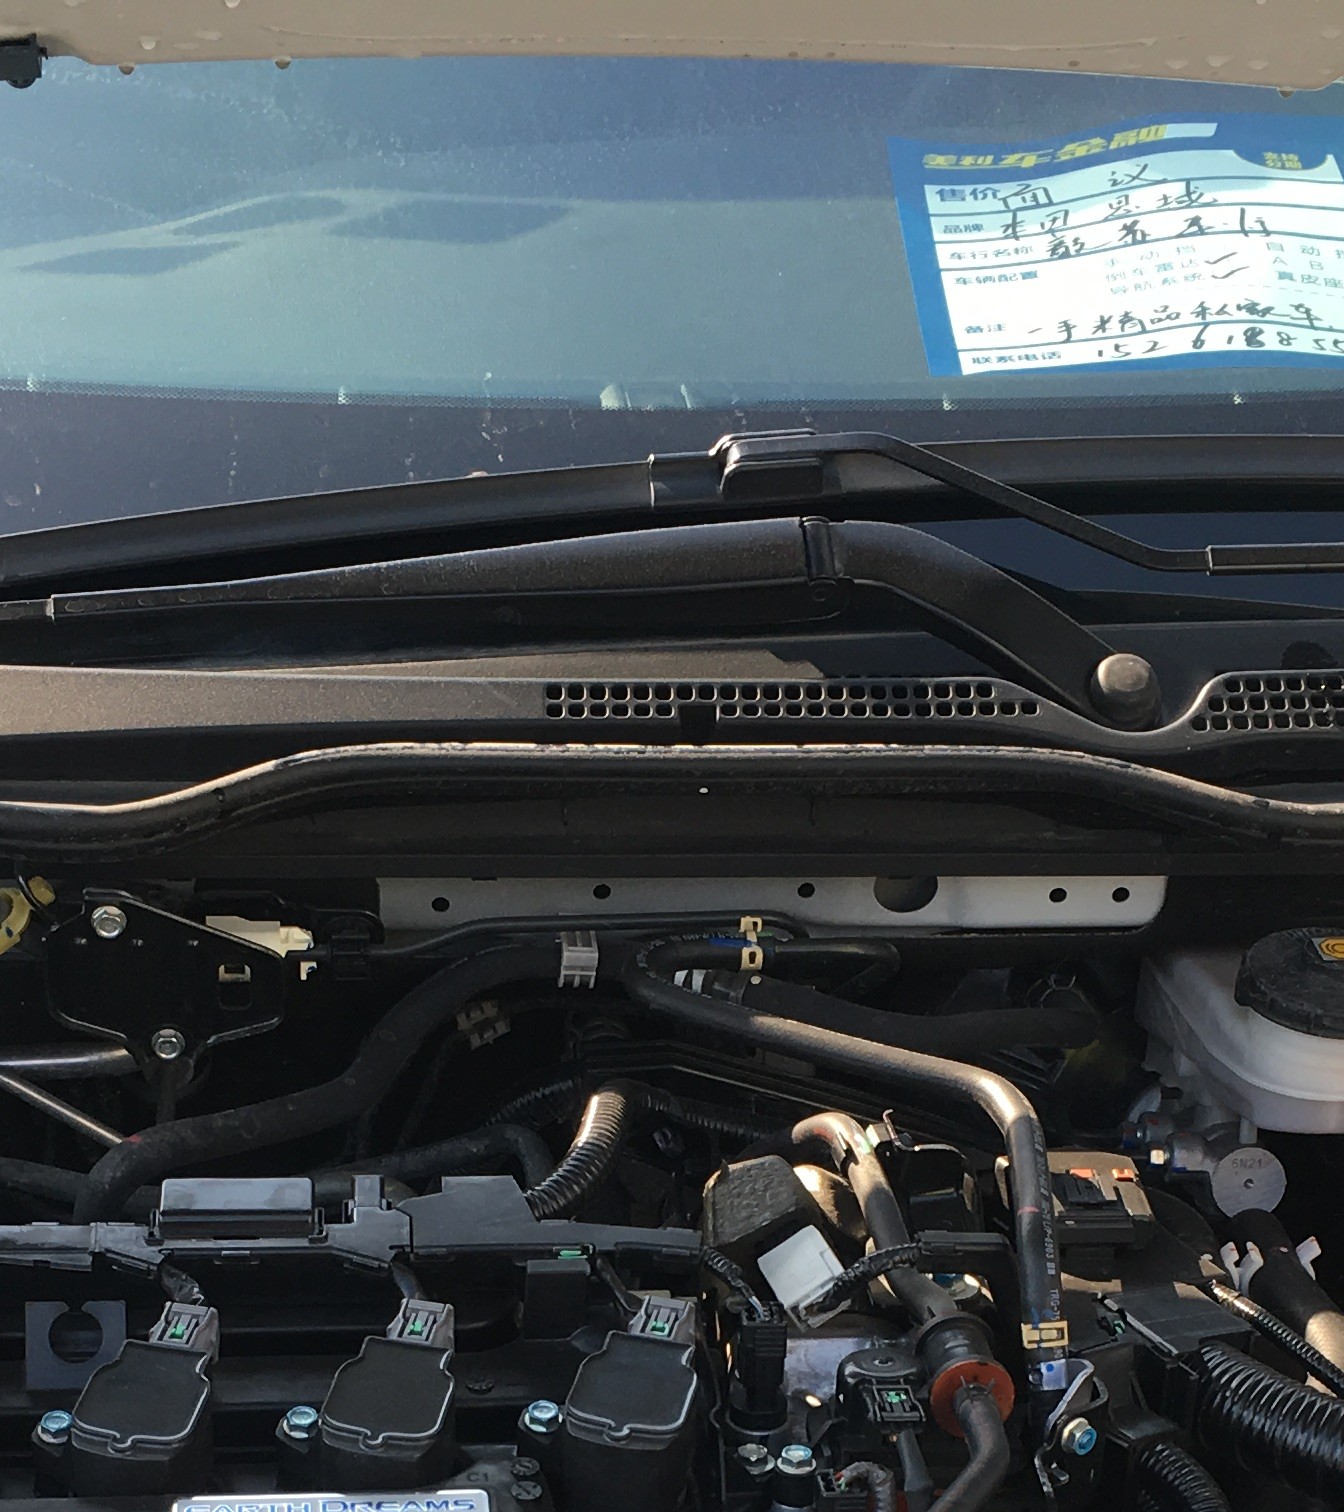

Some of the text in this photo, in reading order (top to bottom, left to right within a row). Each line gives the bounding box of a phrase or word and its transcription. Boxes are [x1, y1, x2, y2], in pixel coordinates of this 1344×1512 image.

[935, 187, 1000, 202] 售价
[943, 223, 985, 235] 品牌
[949, 245, 1034, 260] 车行名称
[954, 269, 1039, 286] 车辆配置
[972, 351, 1062, 365] 联系电话
